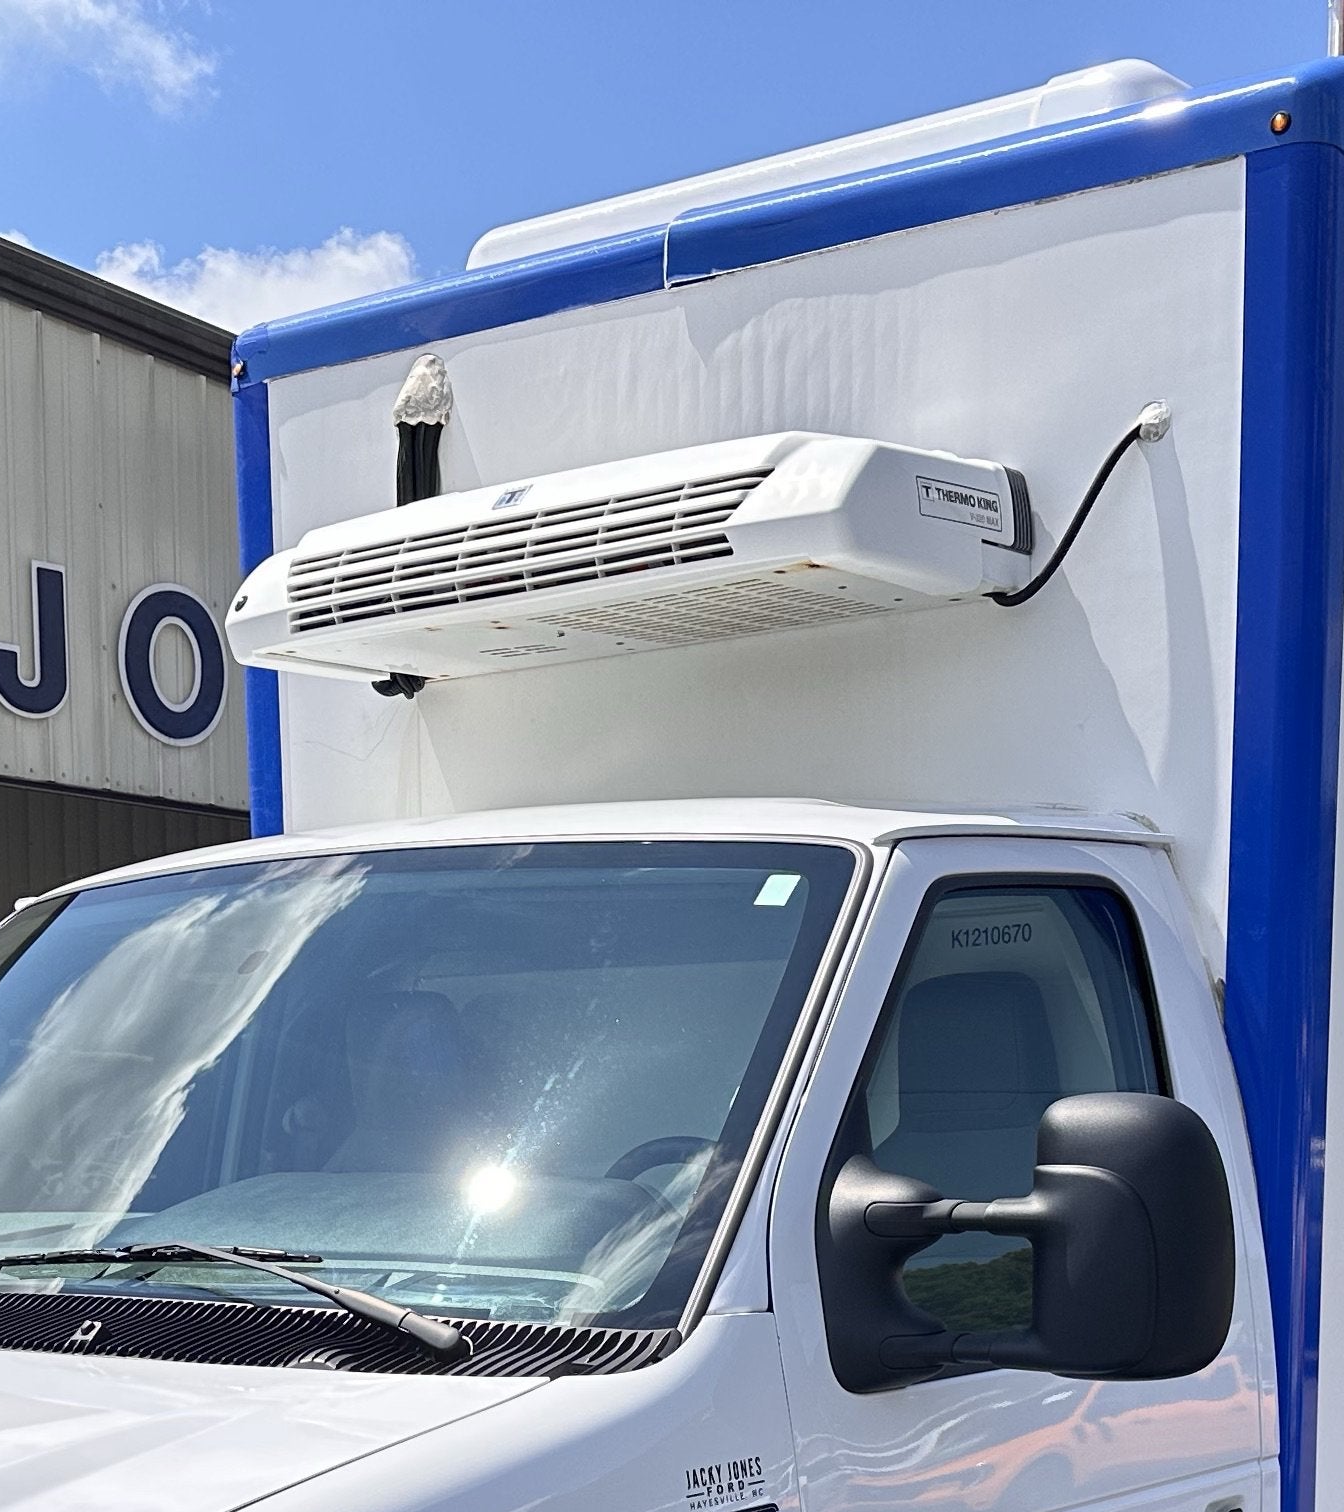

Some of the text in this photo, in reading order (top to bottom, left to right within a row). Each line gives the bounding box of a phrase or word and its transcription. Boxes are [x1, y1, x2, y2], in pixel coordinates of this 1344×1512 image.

[935, 486, 975, 507] THERMO
[977, 496, 999, 513] KING
[950, 923, 1032, 949] K1210670
[685, 1456, 762, 1490] JACKY JONES
[706, 1480, 745, 1497] FORD
[751, 1487, 764, 1498] NC
